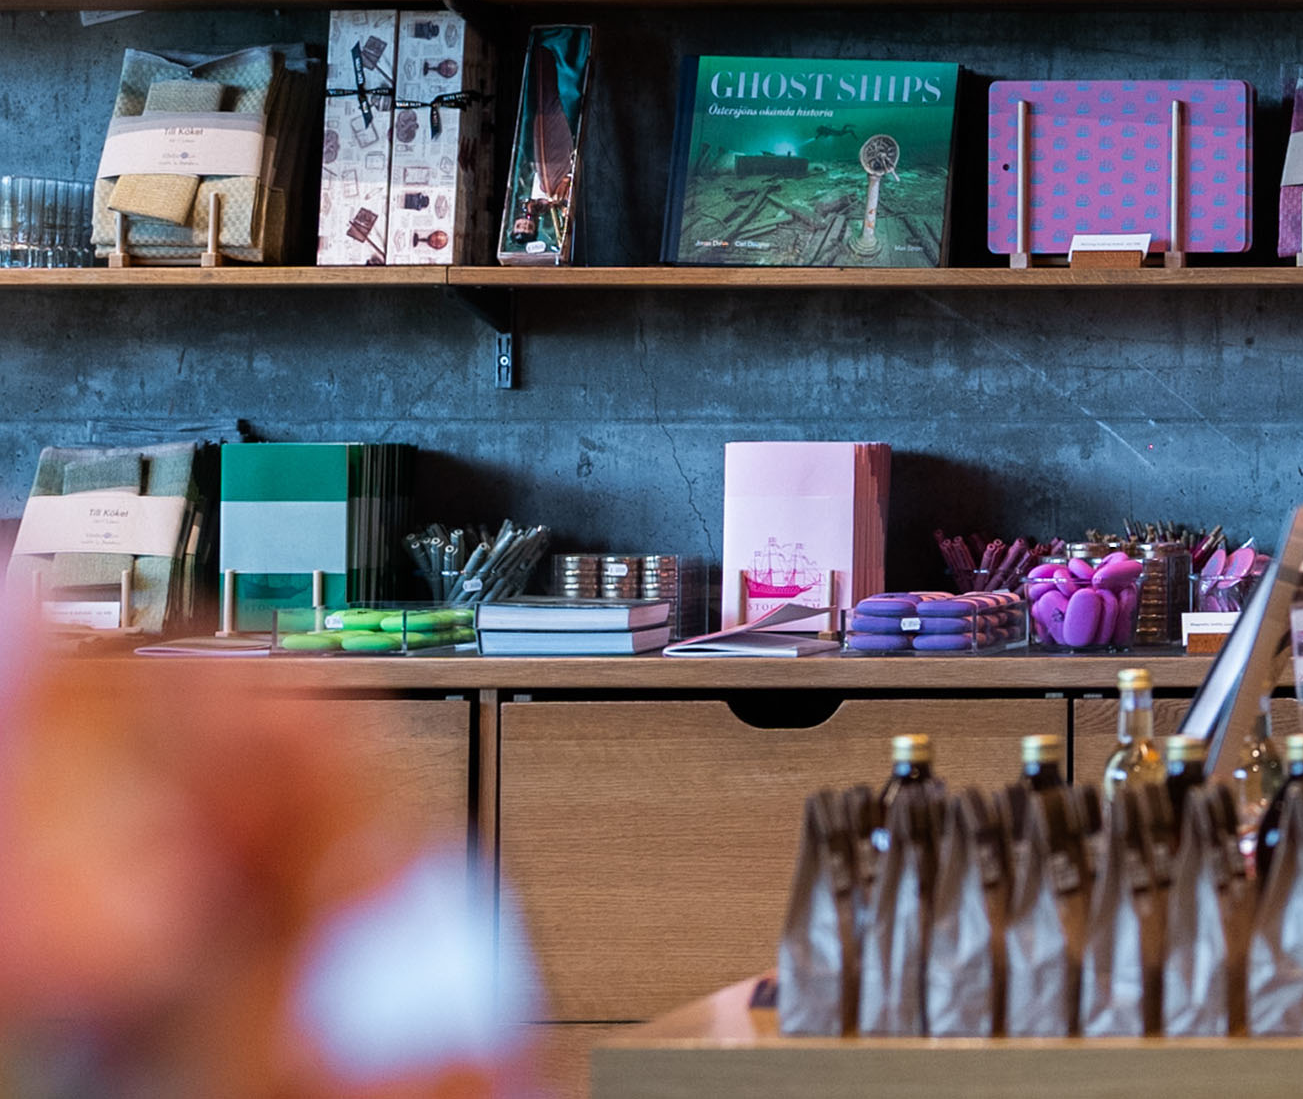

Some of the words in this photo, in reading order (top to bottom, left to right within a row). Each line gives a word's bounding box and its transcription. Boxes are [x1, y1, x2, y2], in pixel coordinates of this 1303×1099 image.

[710, 71, 832, 100] GHOST
[837, 74, 942, 103] SHIPS
[708, 103, 757, 119] Östersjöns
[796, 106, 834, 118] historia
